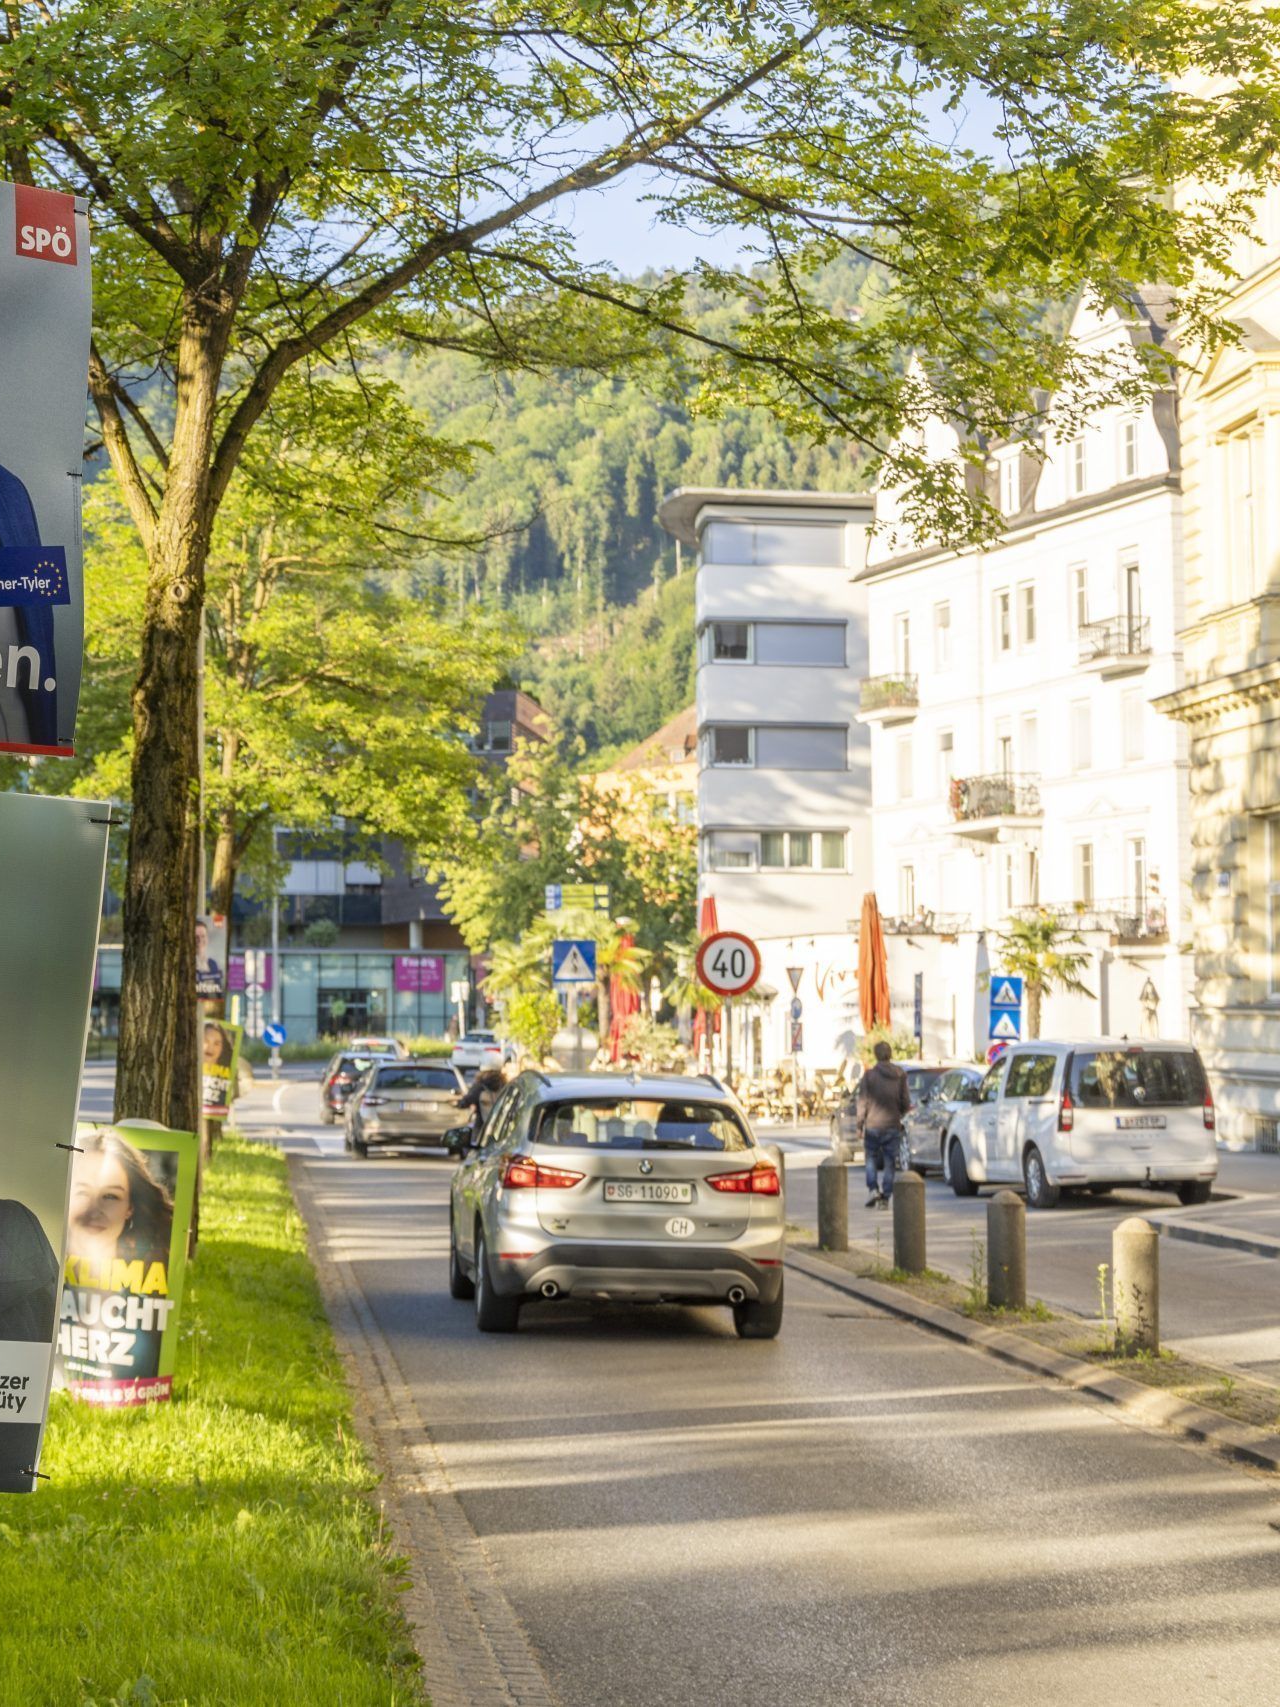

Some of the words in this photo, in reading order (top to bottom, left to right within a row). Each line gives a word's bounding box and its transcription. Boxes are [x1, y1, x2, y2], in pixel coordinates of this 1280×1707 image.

[21, 225, 72, 257] SPÖ
[712, 948, 746, 979] 40
[816, 961, 860, 1001] Viv
[671, 1217, 689, 1233] CH
[61, 1289, 175, 1331] AUCHT
